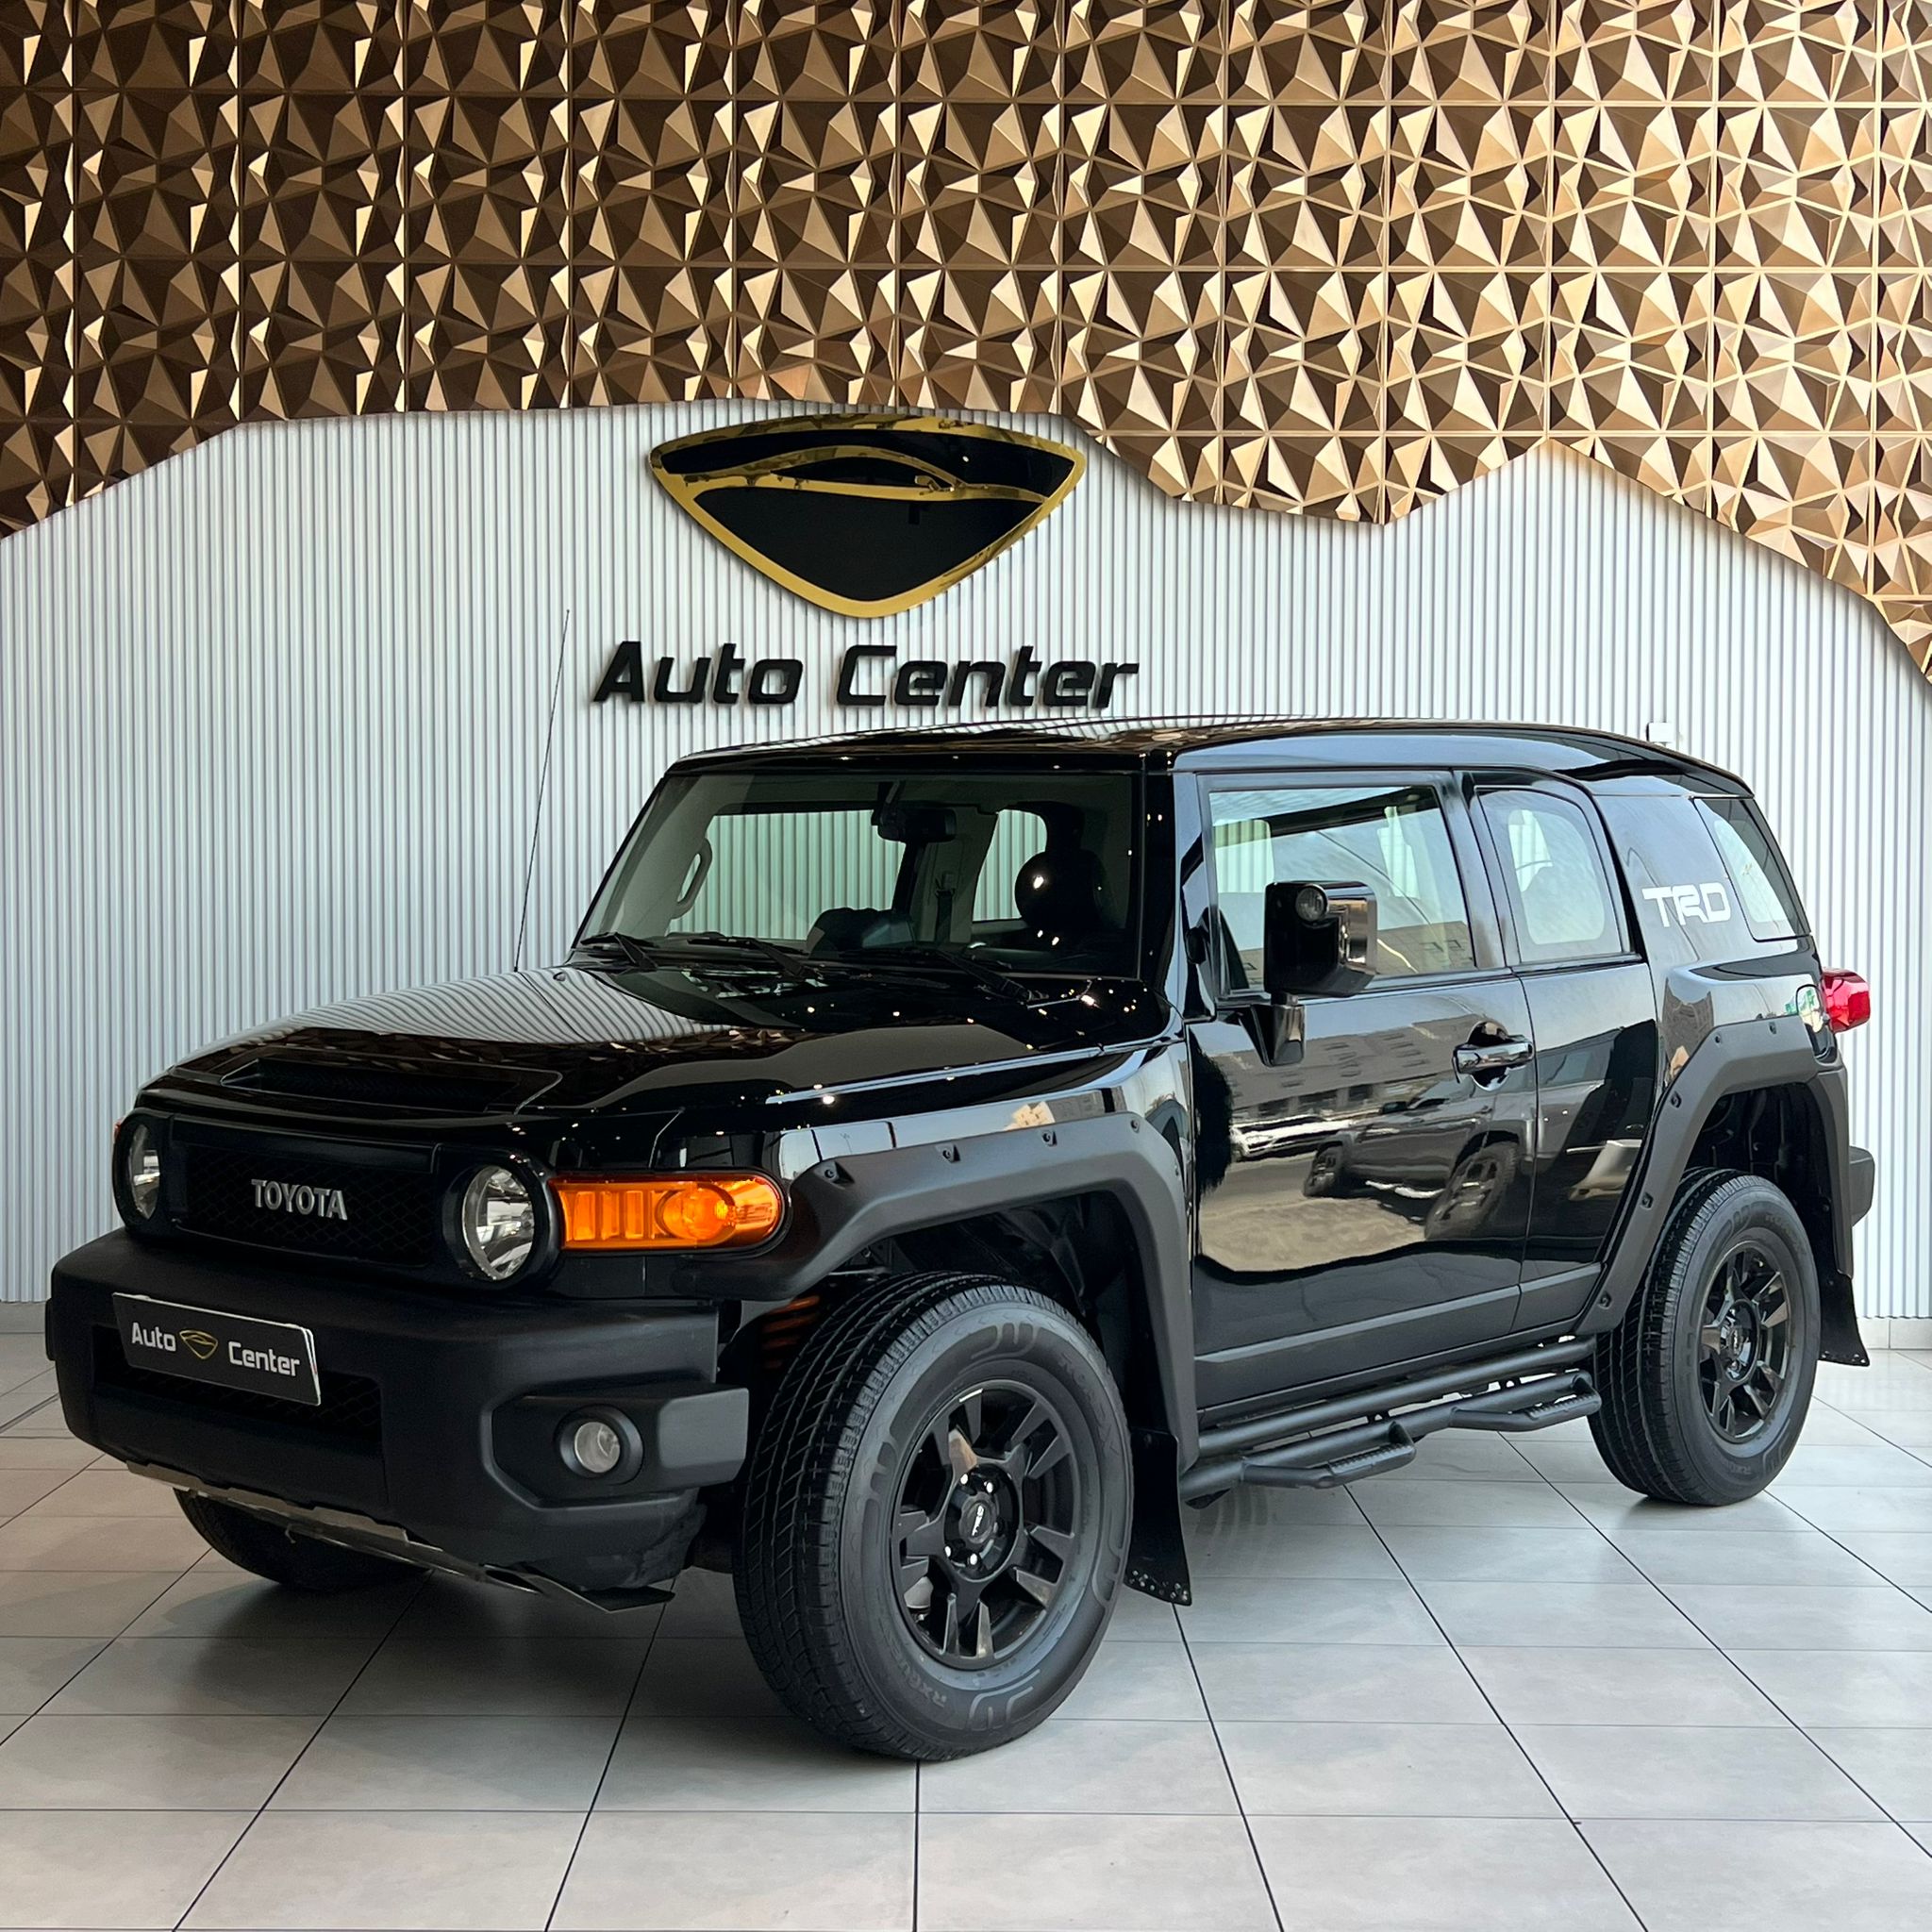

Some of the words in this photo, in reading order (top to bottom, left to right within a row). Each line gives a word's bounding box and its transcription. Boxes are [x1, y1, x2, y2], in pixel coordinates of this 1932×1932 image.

[593, 641, 804, 705] Auto
[837, 644, 1140, 709] Center
[1641, 882, 1731, 928] TRD
[251, 1178, 348, 1221] TOYOTA
[131, 1322, 176, 1352] Auto
[227, 1341, 301, 1377] Center
